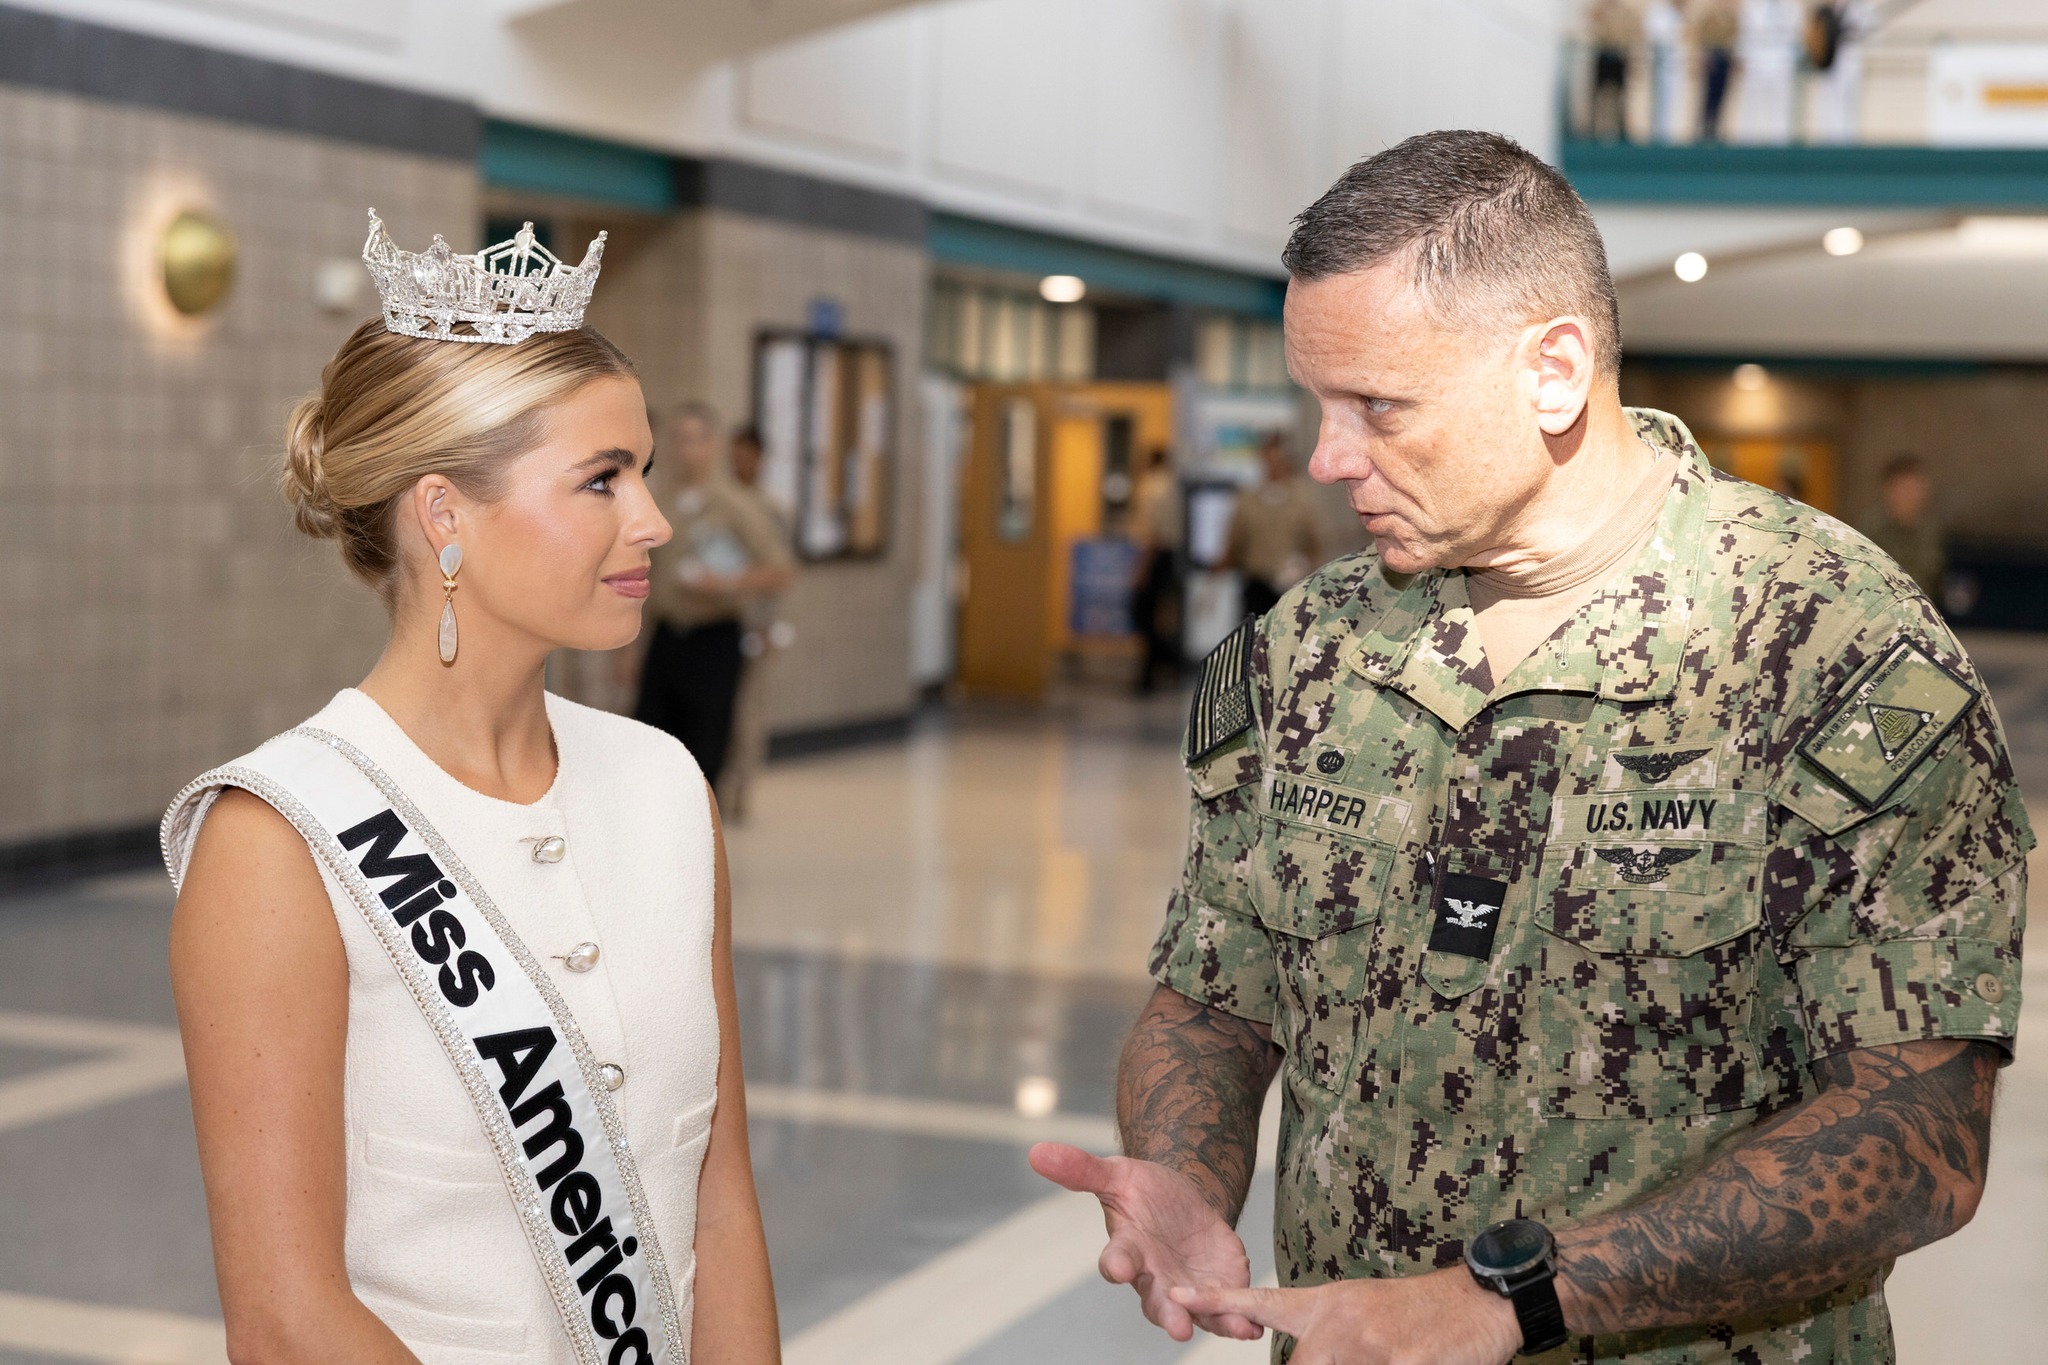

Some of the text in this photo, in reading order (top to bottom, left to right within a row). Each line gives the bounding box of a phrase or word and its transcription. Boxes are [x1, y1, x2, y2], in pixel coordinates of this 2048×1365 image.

[1811, 649, 1911, 753] NAVAL AIR TECHNICAL TRAINING CENTER
[1890, 718, 1944, 773] PENSACOLA, FL
[1270, 780, 1366, 828] HARPER
[1586, 799, 1717, 833] U.S. NAVY
[336, 808, 496, 1008] Miss
